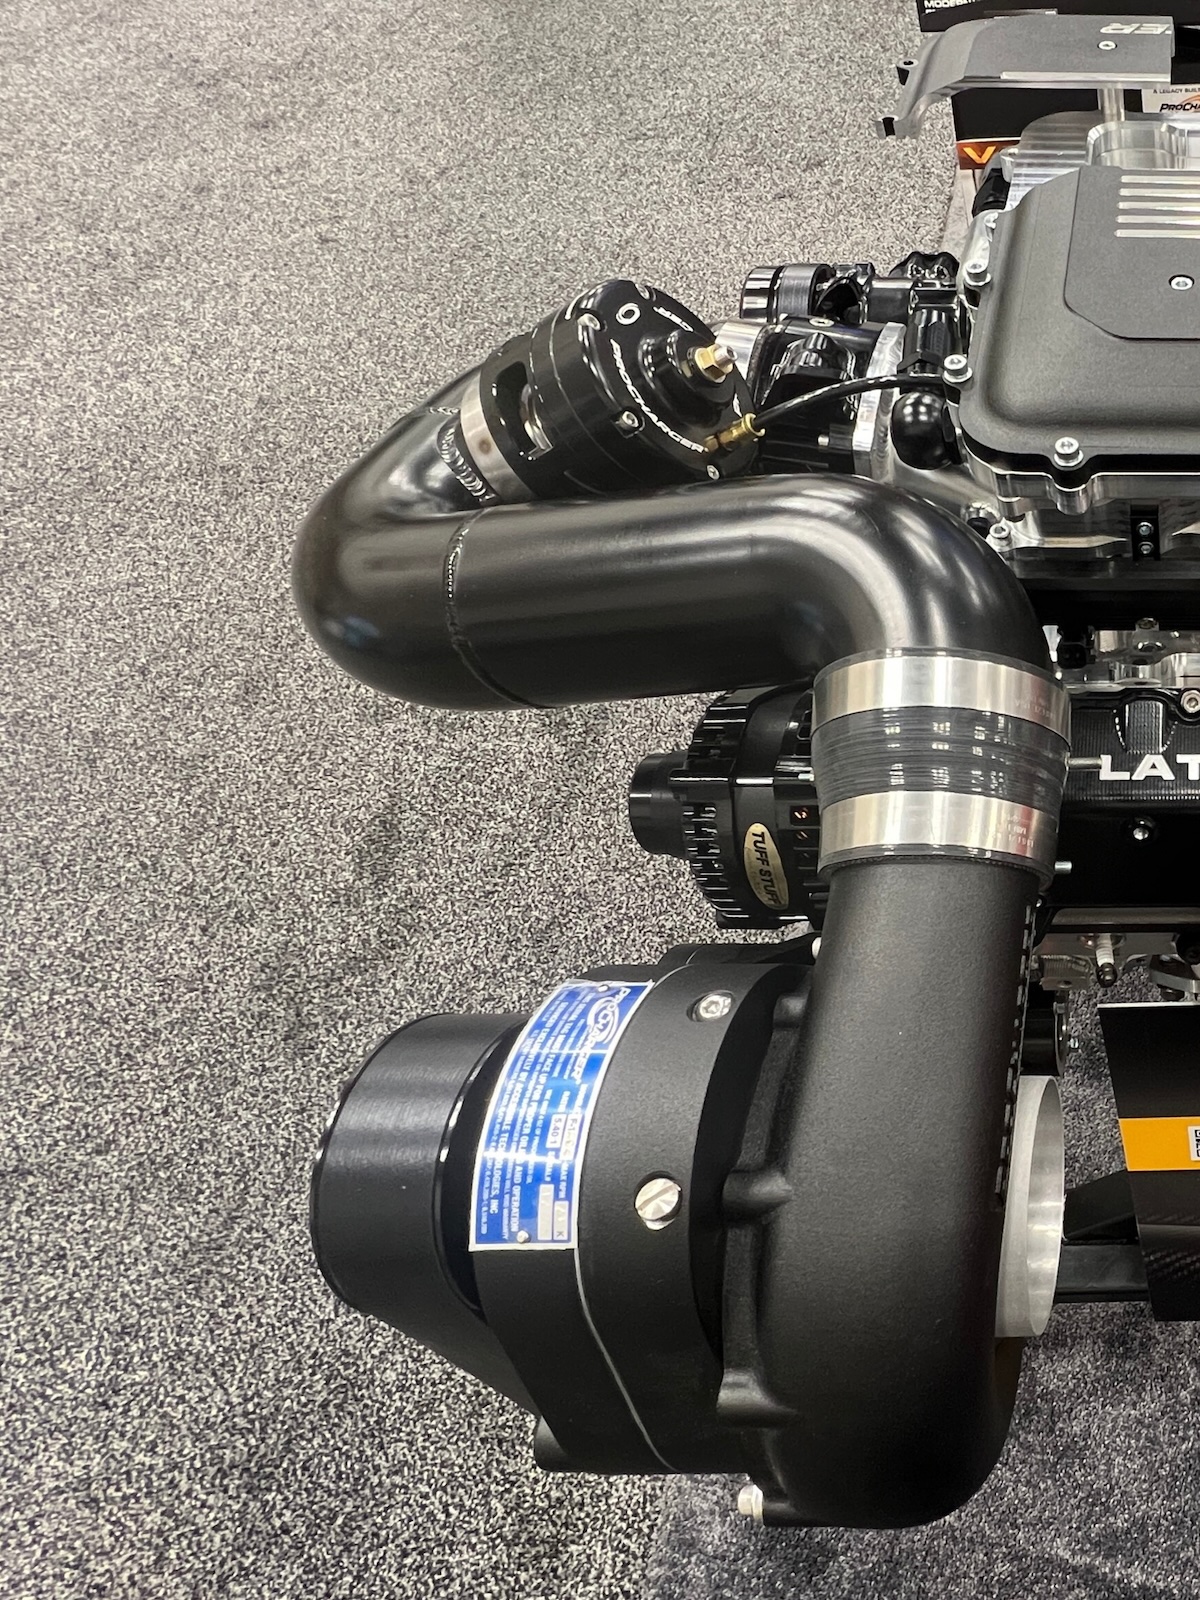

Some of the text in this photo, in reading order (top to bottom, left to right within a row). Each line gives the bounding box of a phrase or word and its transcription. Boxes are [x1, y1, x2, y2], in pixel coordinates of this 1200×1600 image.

[610, 339, 704, 453] PROCHARGER
[752, 831, 770, 866] TUFF
[759, 868, 782, 905] STUFF
[531, 1084, 544, 1100] FOR
[514, 1166, 523, 1184] AND
[490, 1199, 499, 1214] INC
[511, 1185, 521, 1232] OPERATION
